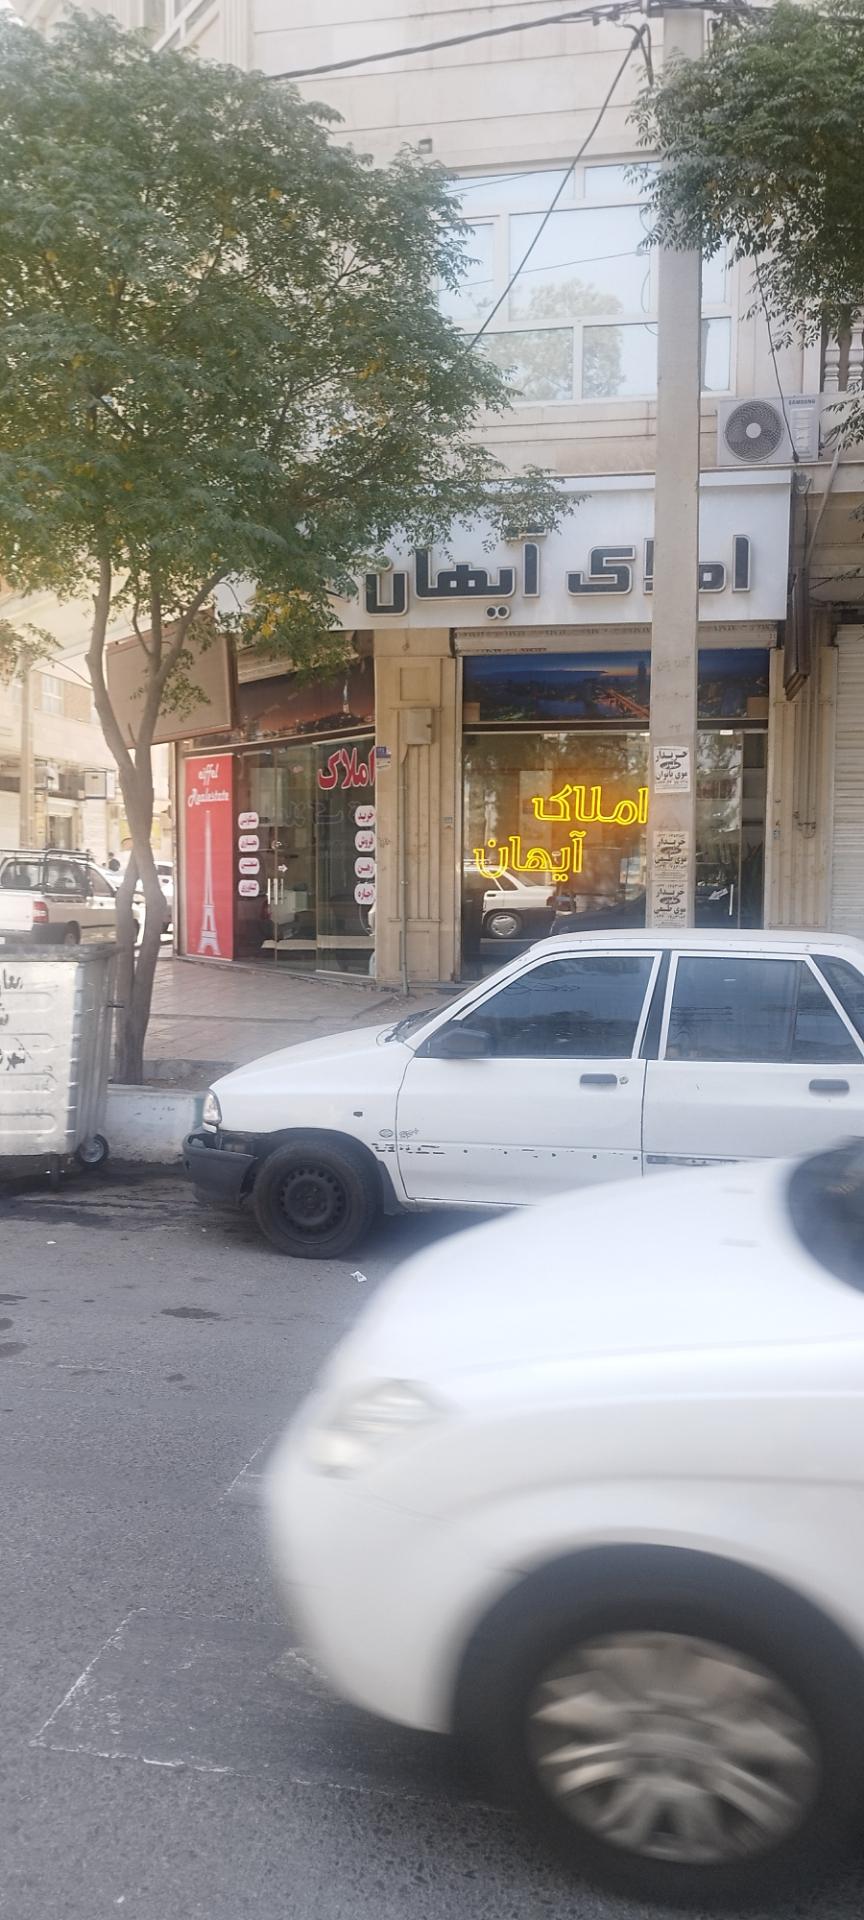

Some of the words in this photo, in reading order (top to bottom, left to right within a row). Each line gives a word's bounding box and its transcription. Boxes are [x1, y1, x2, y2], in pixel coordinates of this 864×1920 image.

[318, 746, 376, 790] املاک
[532, 784, 648, 825] املاک
[357, 811, 374, 823] خرید
[358, 834, 374, 849] فروش
[473, 830, 586, 882] آیهان
[357, 863, 373, 875] رهن
[357, 887, 373, 901] اجاره
